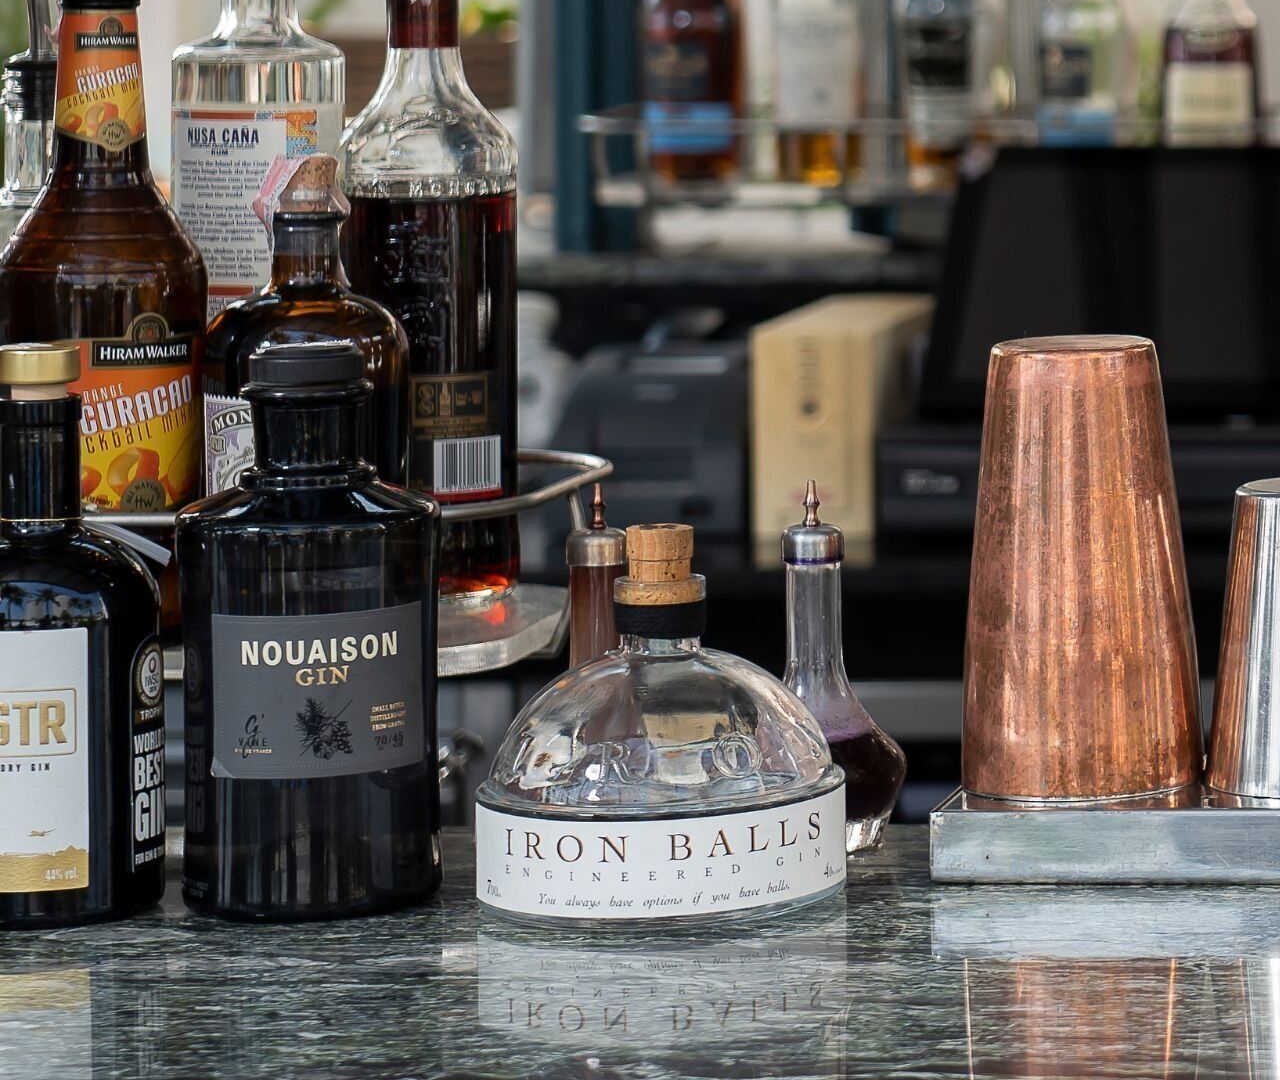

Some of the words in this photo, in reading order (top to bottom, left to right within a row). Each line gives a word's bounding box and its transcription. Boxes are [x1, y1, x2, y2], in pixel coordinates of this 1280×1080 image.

[80, 35, 109, 47] HIRAM
[77, 62, 139, 94] CURACAO
[187, 126, 216, 144] NUSA
[221, 124, 259, 143] CAÑA
[211, 148, 229, 157] RUM
[100, 346, 145, 361] HIRAM
[147, 343, 187, 359] WALKER
[83, 382, 125, 404] RANGE
[80, 373, 192, 435] CURACAO
[213, 410, 252, 431] MON
[241, 630, 398, 666] NOUAISON
[295, 665, 350, 686] GIN
[371, 703, 389, 713] SMALL
[238, 737, 269, 747] VINE
[31, 762, 50, 771] GIN
[134, 752, 165, 791] BEST
[135, 792, 165, 842] GIN
[505, 827, 630, 863] IRON
[667, 810, 821, 861] BALLS
[505, 864, 741, 882] ENGINEERED
[776, 846, 821, 867] GIN
[538, 892, 557, 905] You
[565, 894, 601, 908] always
[609, 895, 634, 908] have
[643, 891, 683, 908] options
[692, 891, 704, 907] if
[710, 892, 731, 905] you
[739, 885, 761, 899] have
[766, 878, 790, 895] balls.
